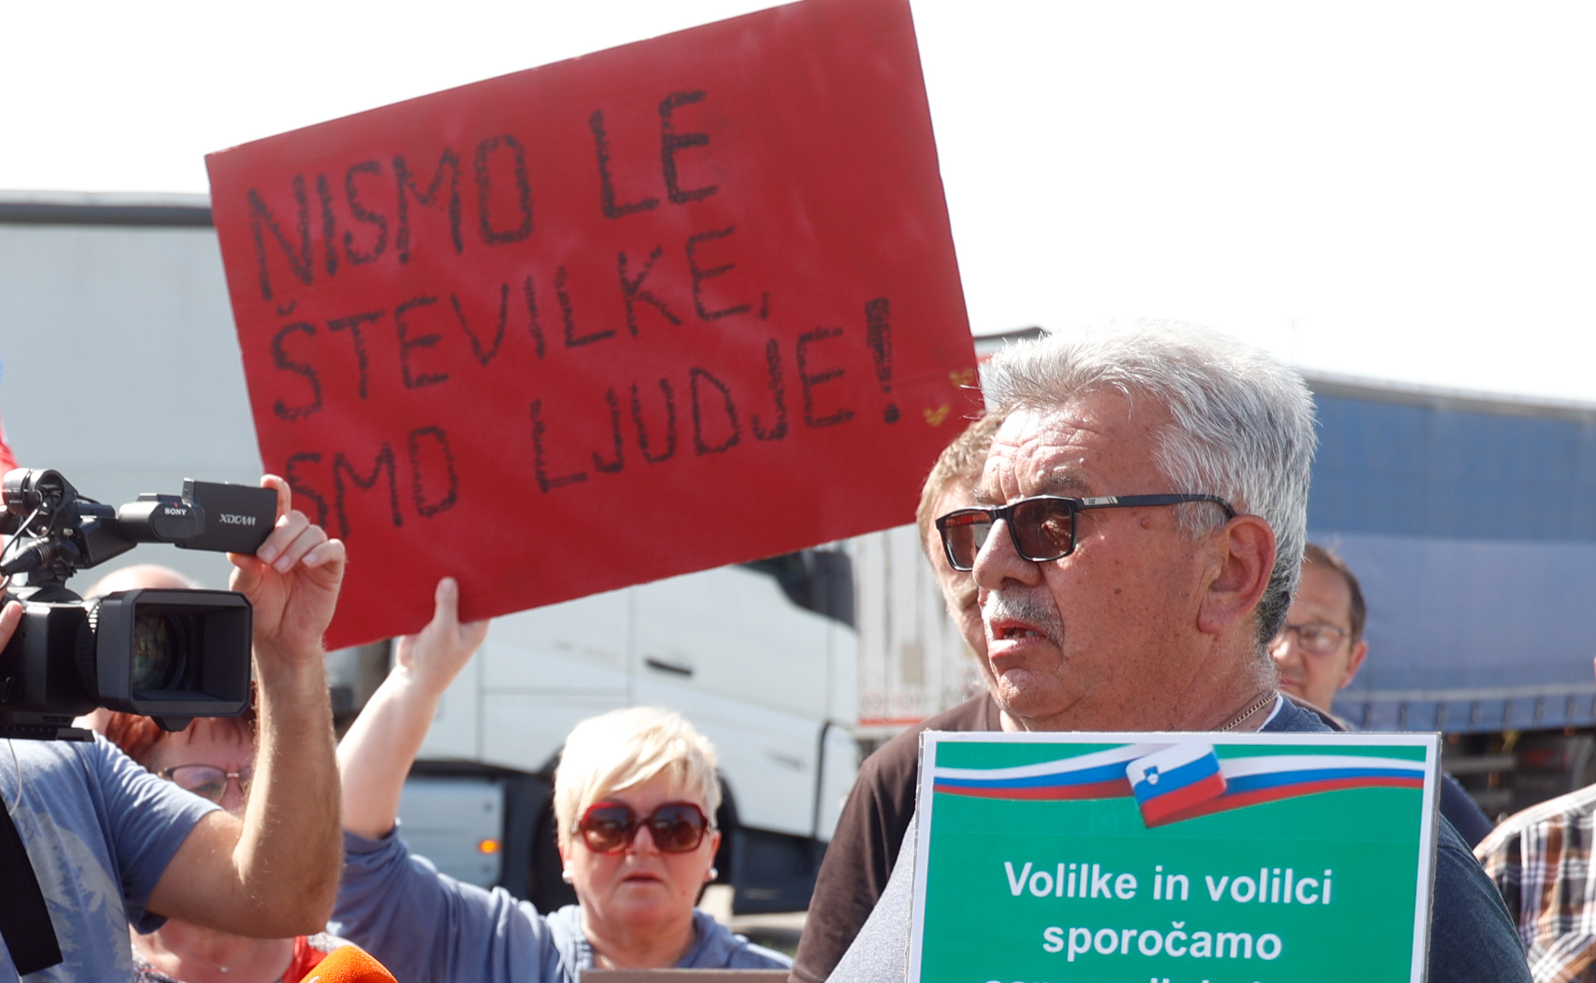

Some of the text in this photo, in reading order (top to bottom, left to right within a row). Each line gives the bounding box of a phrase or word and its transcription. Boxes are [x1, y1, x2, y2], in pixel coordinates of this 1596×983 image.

[248, 90, 719, 302] NISMO LE
[284, 297, 901, 540] SMO LJUDJE!
[164, 507, 187, 516] SONY
[219, 513, 256, 526] XDCAM
[1004, 861, 1333, 906] Volilke in volilci
[1042, 920, 1283, 963] sporočamo
